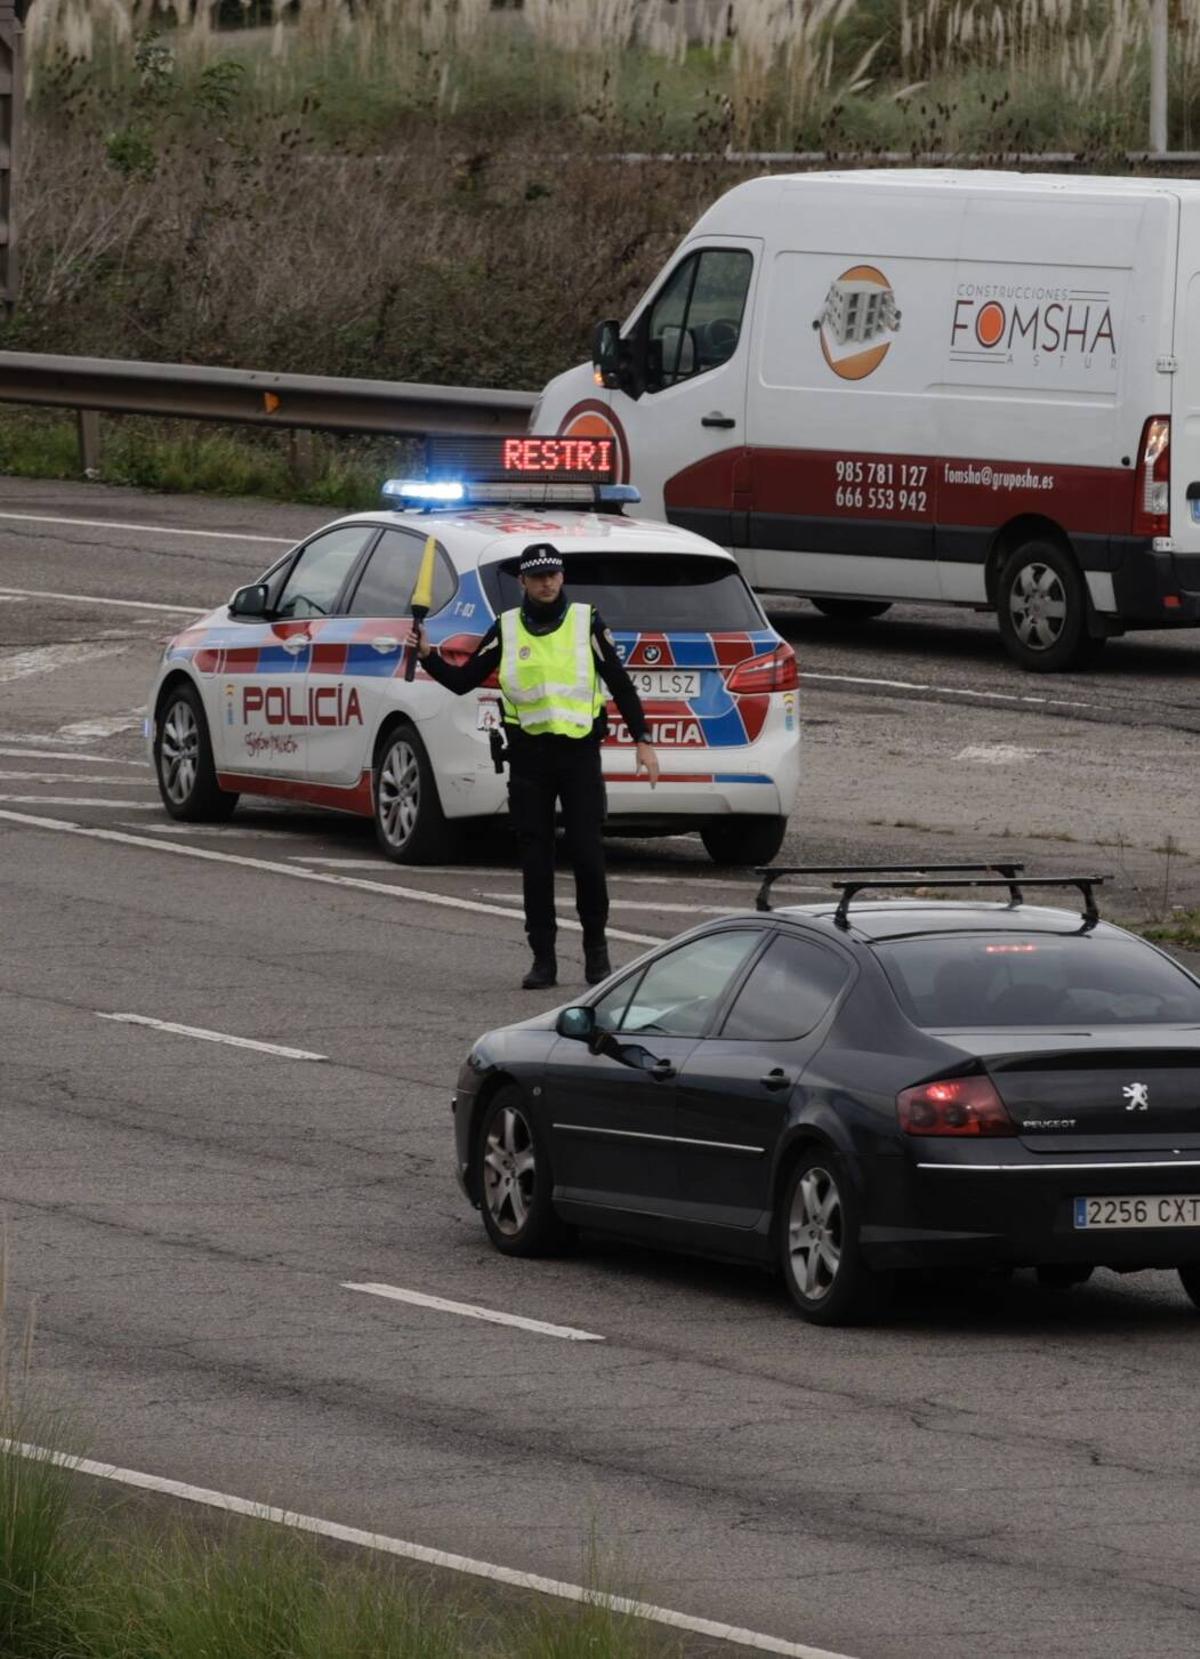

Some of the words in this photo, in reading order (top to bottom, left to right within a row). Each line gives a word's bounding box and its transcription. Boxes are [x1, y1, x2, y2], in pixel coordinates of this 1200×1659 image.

[956, 283, 1069, 300] CONSTRUCCIONES
[951, 300, 1117, 355] FOMSHA
[504, 439, 611, 470] RESTRI
[836, 460, 863, 483] 985
[867, 463, 893, 485] 781
[901, 465, 927, 487] 127
[944, 463, 1054, 491] fomsha@gruposha.es
[836, 486, 862, 507] 666
[868, 488, 894, 510] 553
[900, 490, 927, 512] 942
[659, 674, 695, 694] LSZ
[243, 682, 364, 727] POLICÍA
[1023, 1119, 1076, 1128] PEUGEOT
[1089, 1200, 1147, 1224] 2256
[1158, 1199, 1200, 1222] CXT
